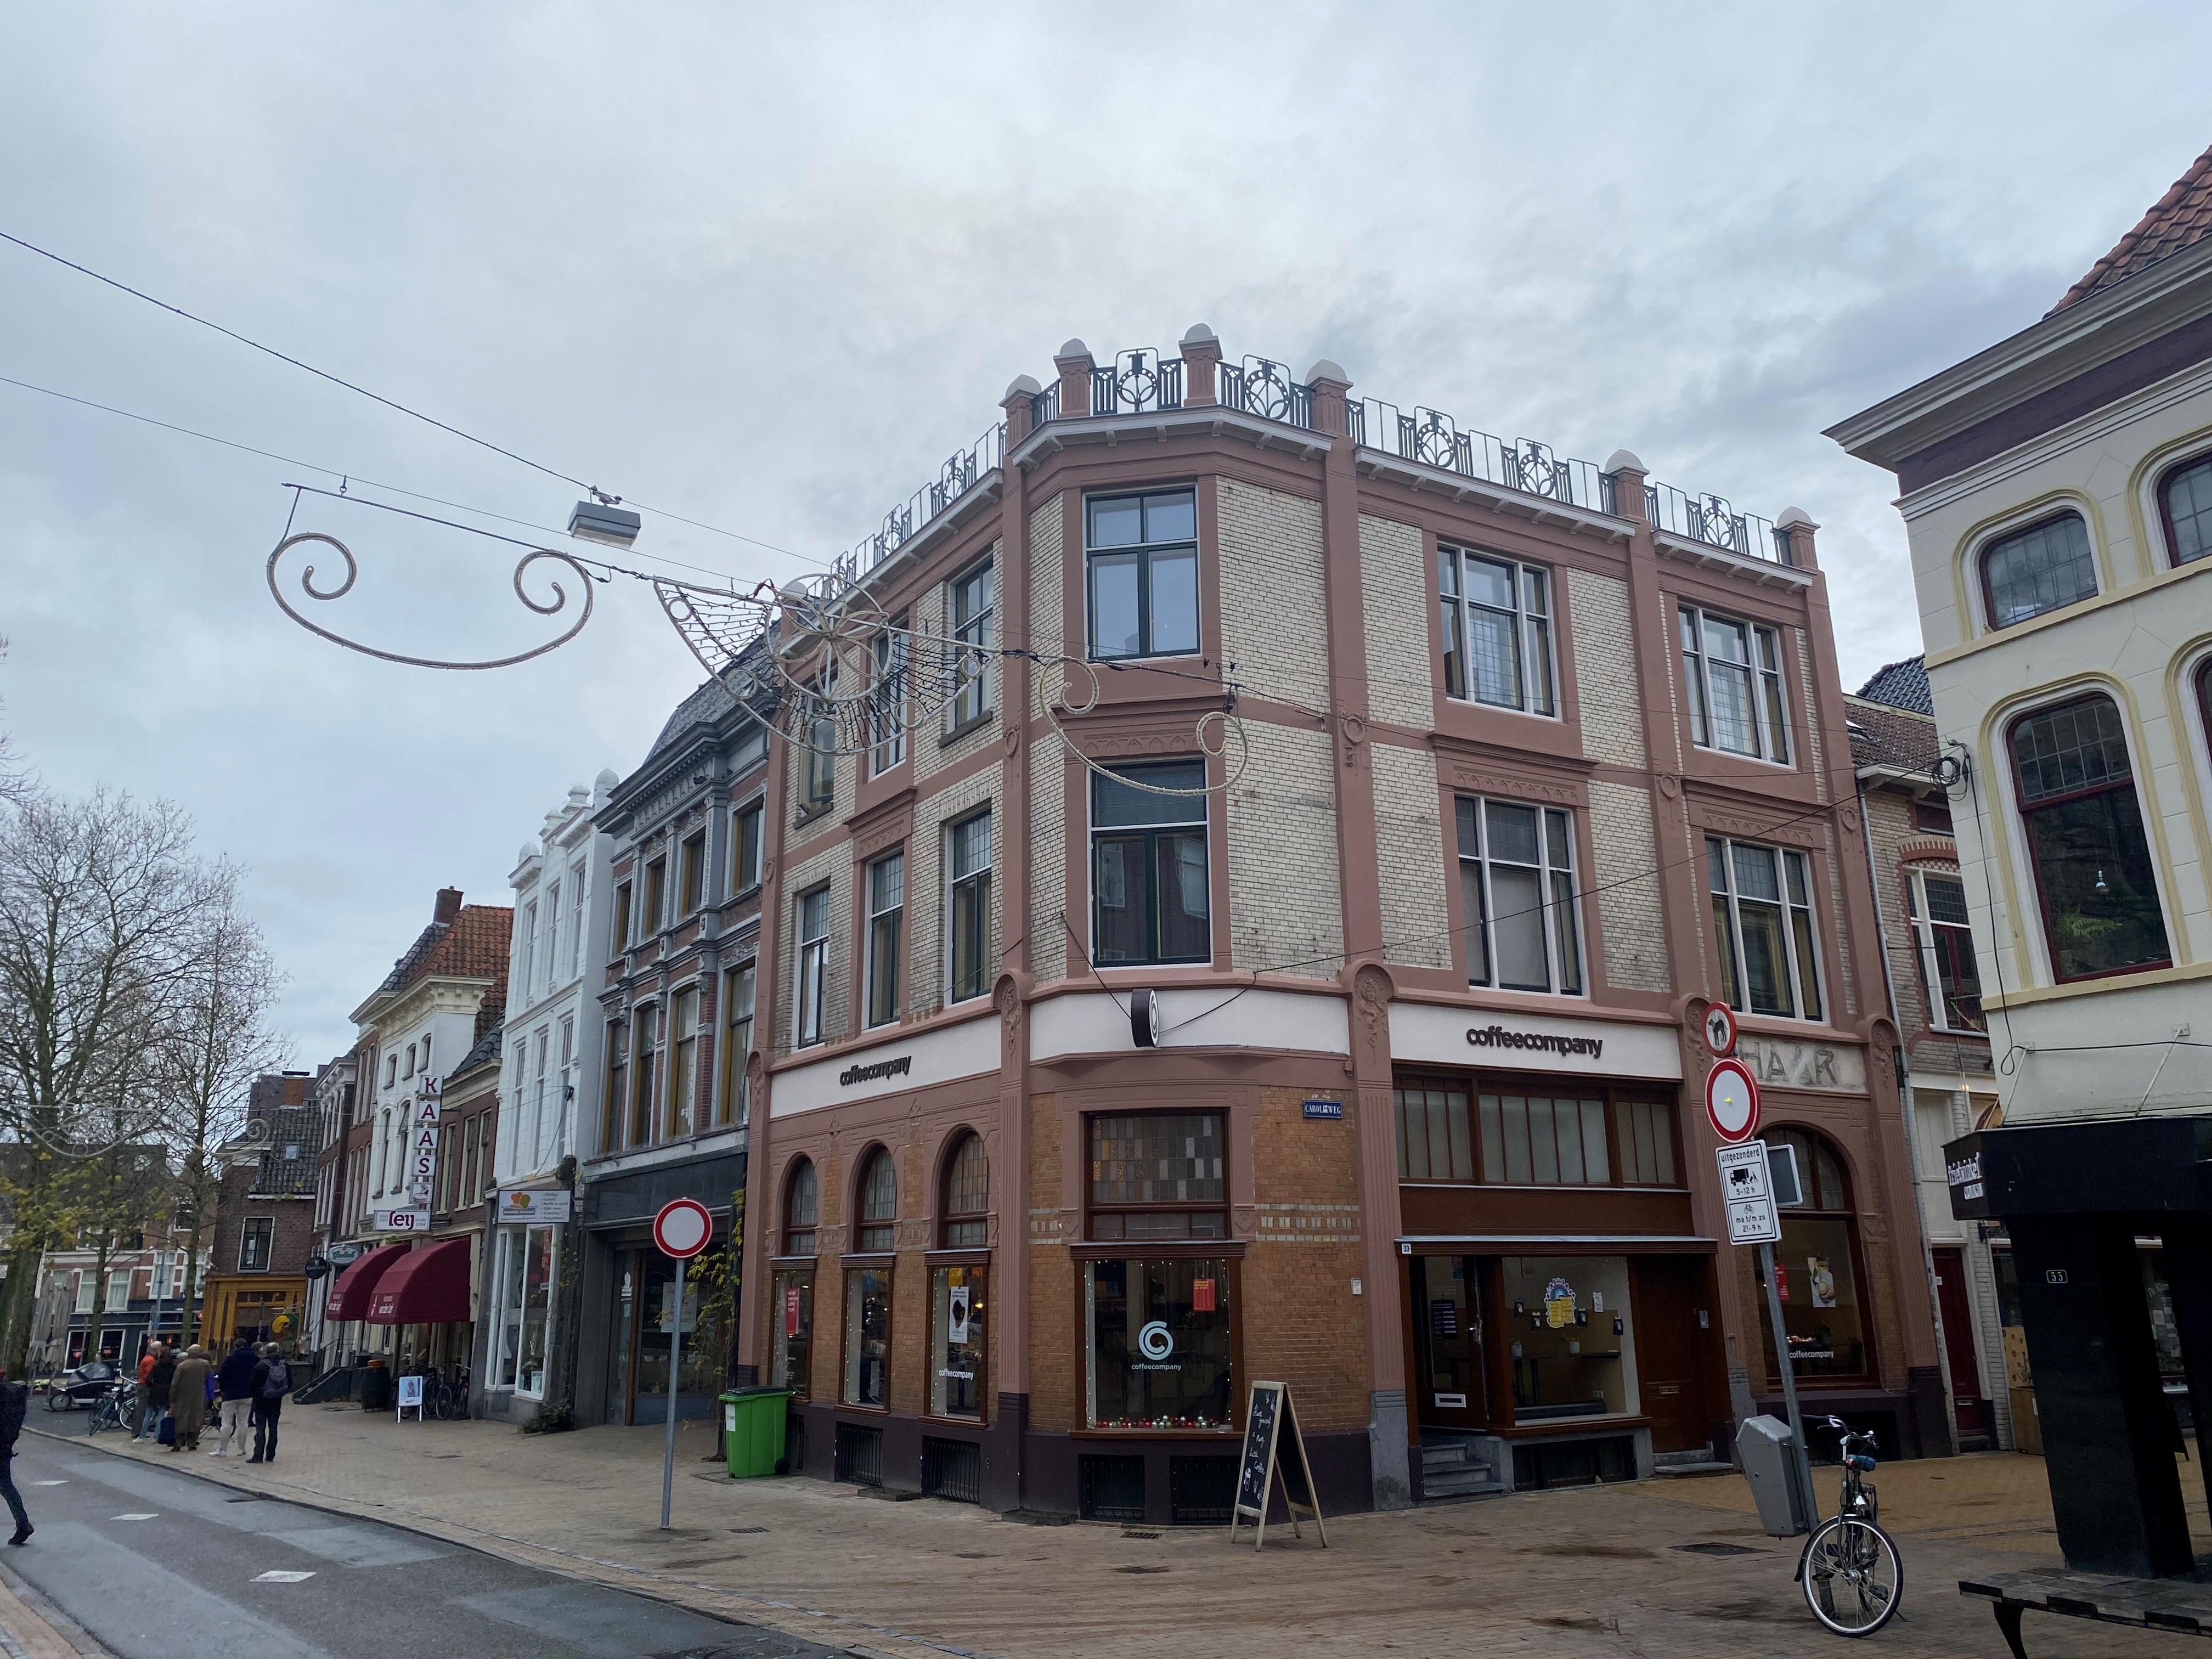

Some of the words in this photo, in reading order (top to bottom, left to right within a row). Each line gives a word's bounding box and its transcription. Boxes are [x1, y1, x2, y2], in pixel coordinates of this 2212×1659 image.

[1466, 1025, 1603, 1059] coffeecompany
[839, 1056, 912, 1086] coffeecompany
[1720, 1148, 1760, 1164] uitgezonderd
[1736, 1187, 1750, 1195] 5-12
[1746, 1214, 1758, 1222] t/m
[1742, 1224, 1756, 1232] 21-9
[2051, 1272, 2063, 1282] 55
[1789, 1350, 1835, 1359] coffeecompany
[939, 1368, 974, 1380] coffeecompany
